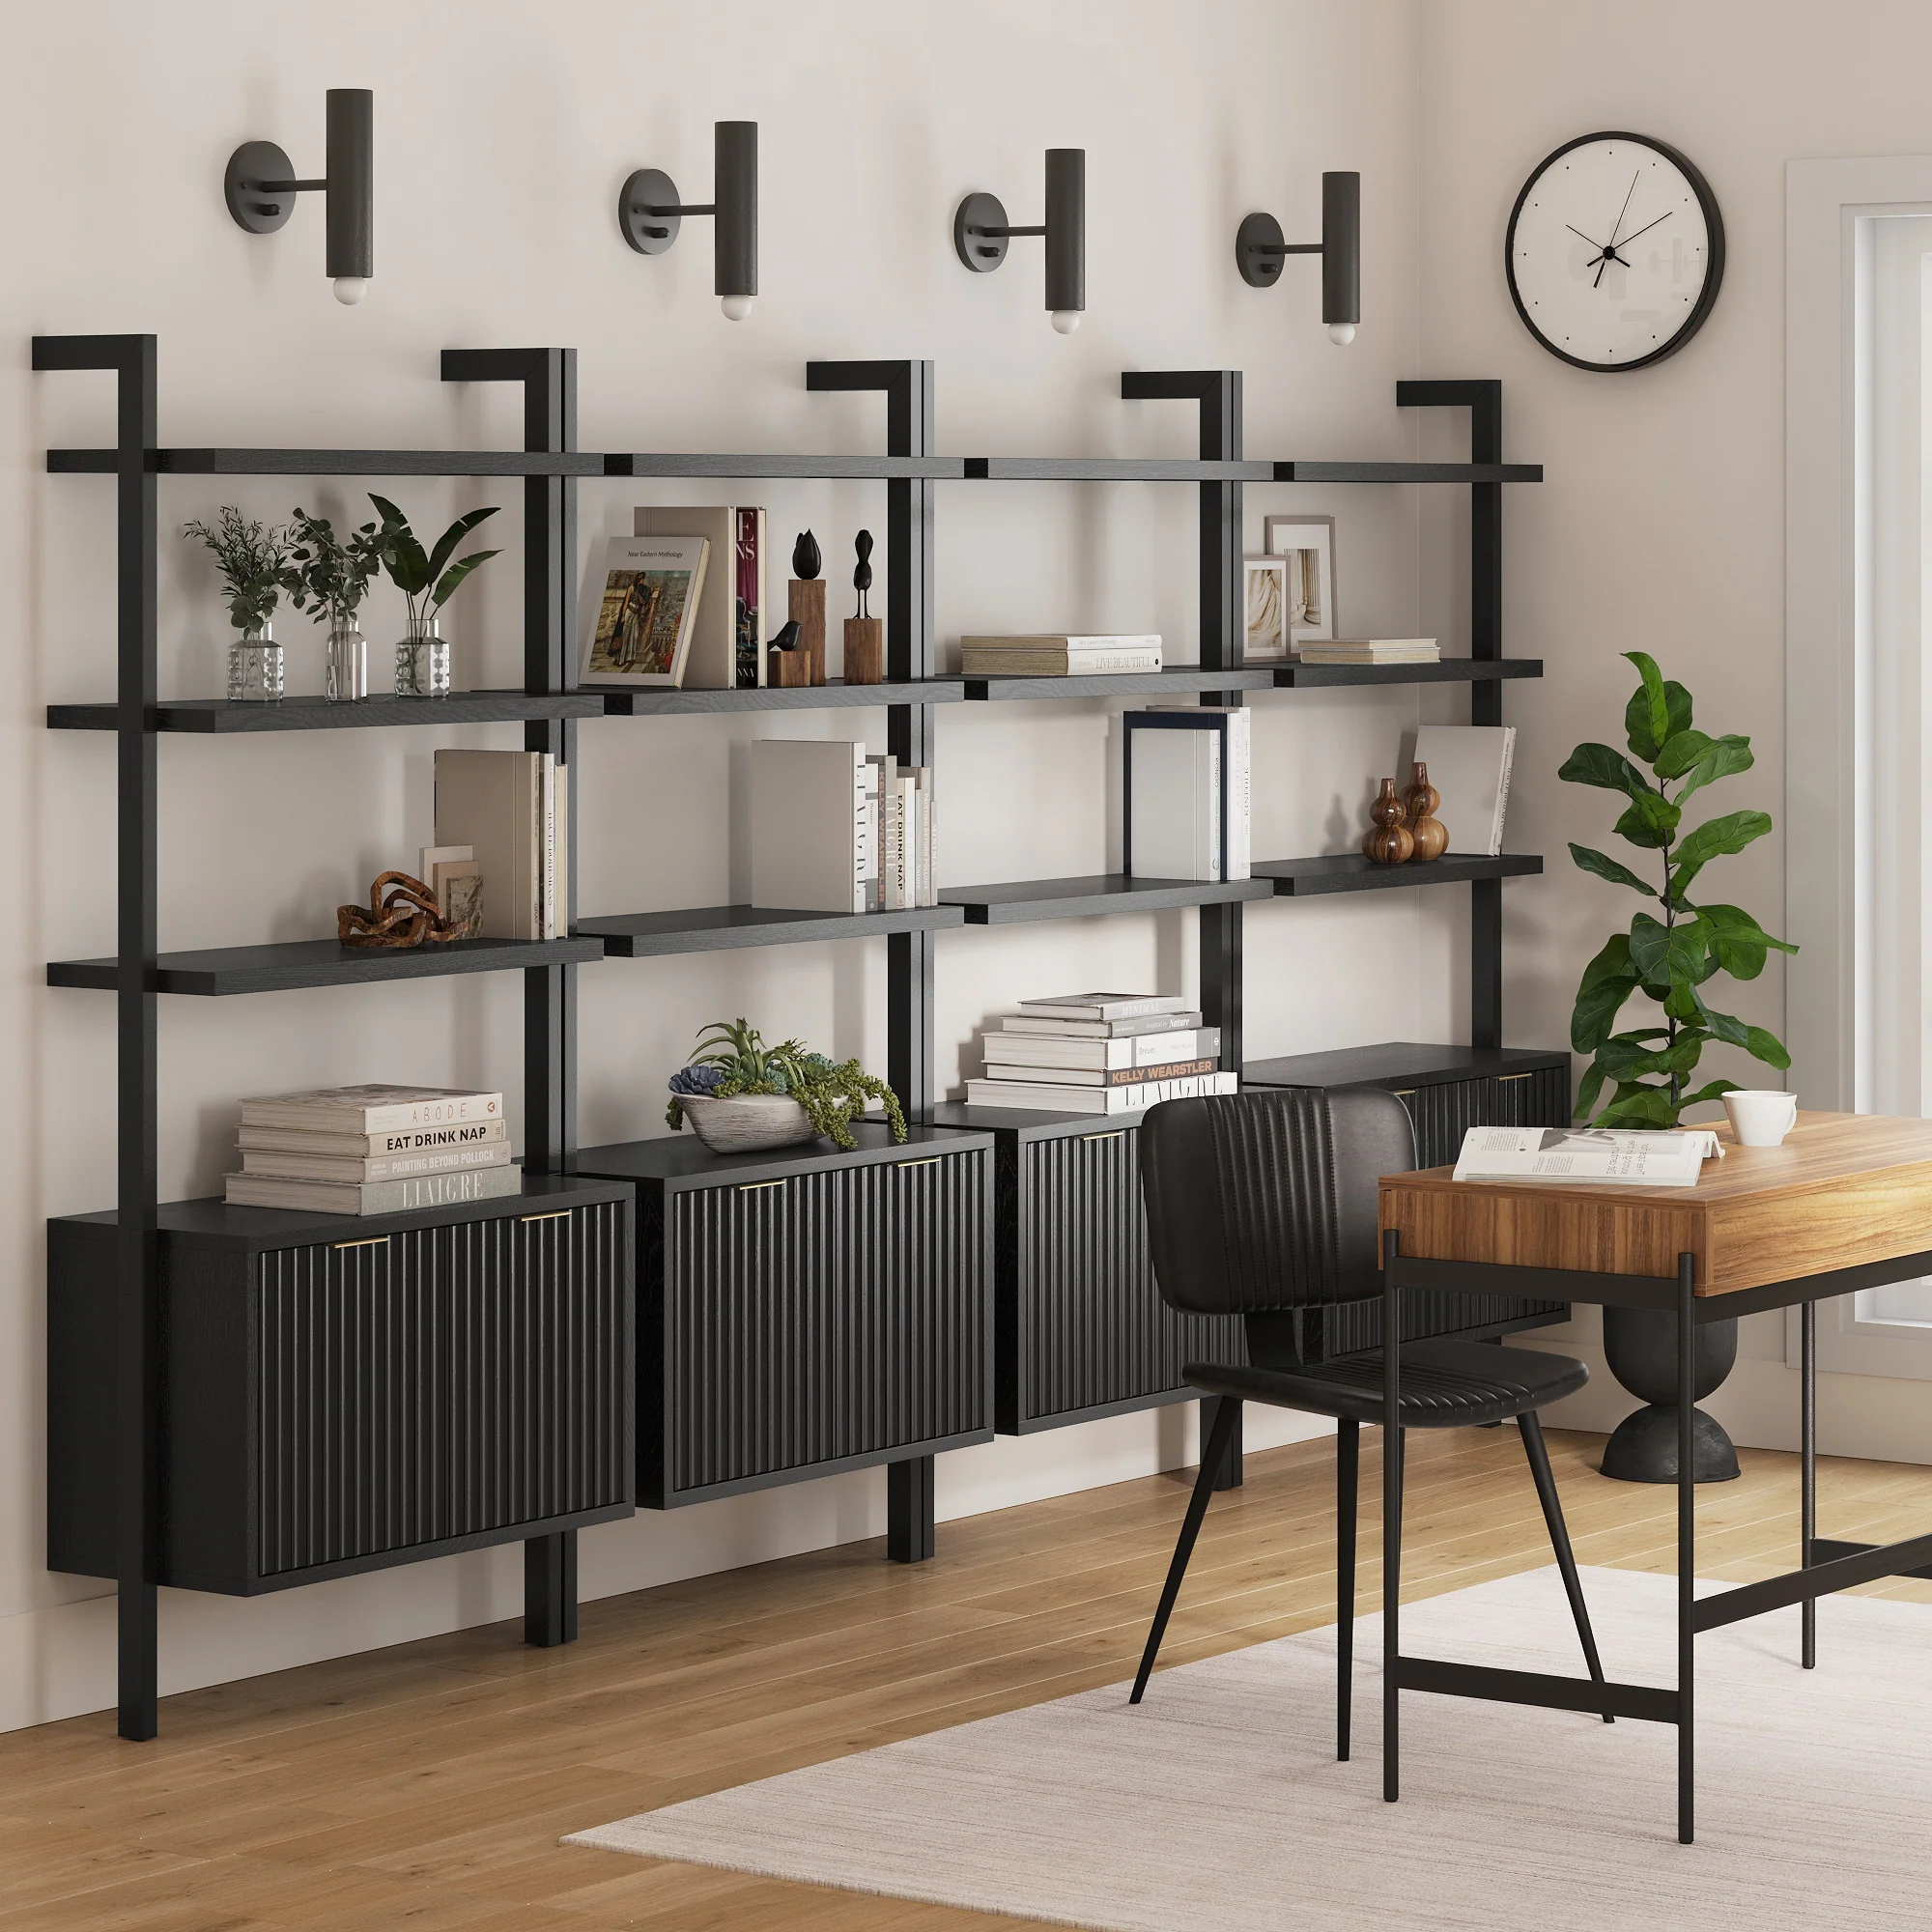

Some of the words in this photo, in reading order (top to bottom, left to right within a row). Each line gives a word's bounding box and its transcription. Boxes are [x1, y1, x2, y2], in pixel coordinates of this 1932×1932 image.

[658, 551, 684, 559] Mythology
[1122, 1003, 1159, 1015] MINIMAL
[1169, 1017, 1190, 1028] Nature
[1138, 1046, 1156, 1055] Breuer
[1112, 1068, 1146, 1084] KELLY
[1148, 1060, 1212, 1079] WEARSTLER
[412, 1103, 467, 1122] ABODE
[386, 1136, 412, 1151] EAT
[414, 1130, 456, 1147] DRINK
[460, 1126, 487, 1141] NAP
[392, 1157, 427, 1174] PAINTING
[429, 1154, 459, 1169] BEYOND
[461, 1150, 495, 1165] POLLOCK
[403, 1173, 483, 1208] LIAIGRE
